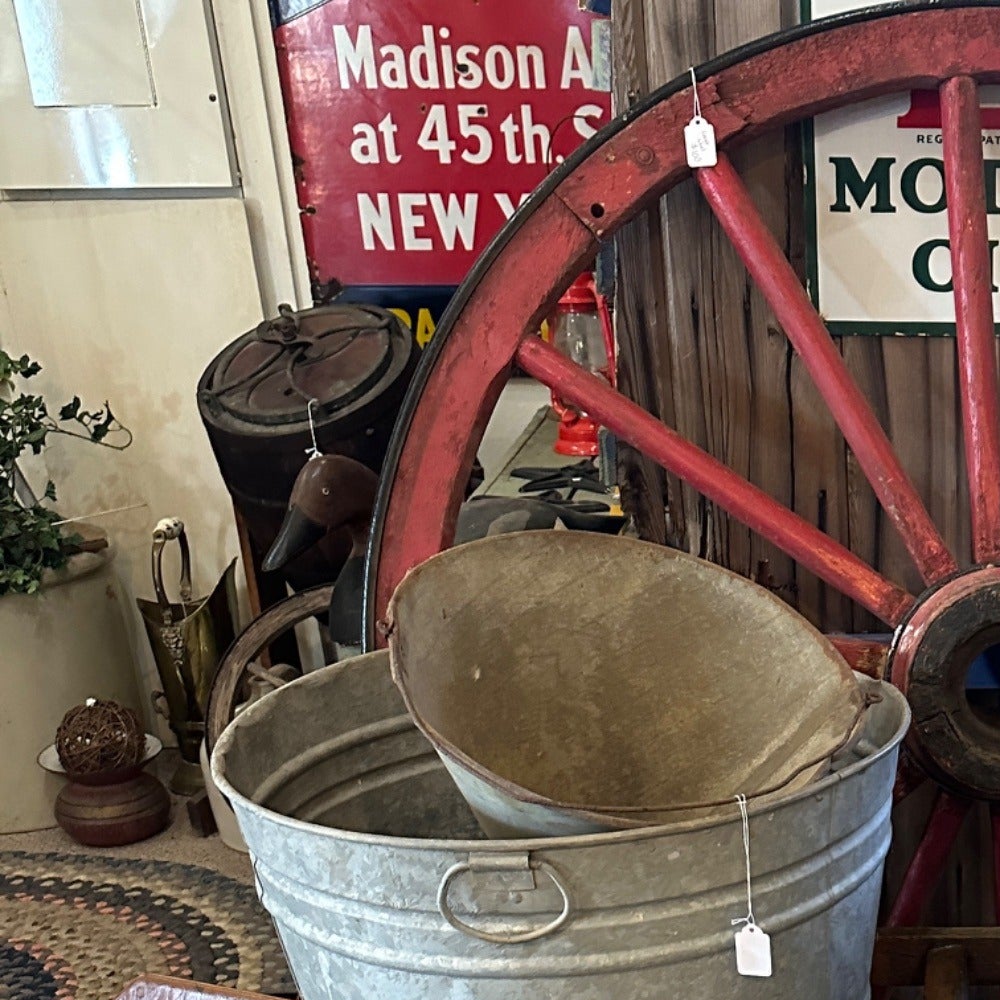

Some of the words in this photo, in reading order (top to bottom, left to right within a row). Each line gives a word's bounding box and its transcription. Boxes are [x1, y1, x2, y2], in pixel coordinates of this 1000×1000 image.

[332, 24, 546, 90] Madison
[560, 26, 593, 90] A
[350, 113, 402, 164] at
[573, 104, 605, 141] S
[917, 134, 942, 144] REG
[357, 192, 479, 251] NEW
